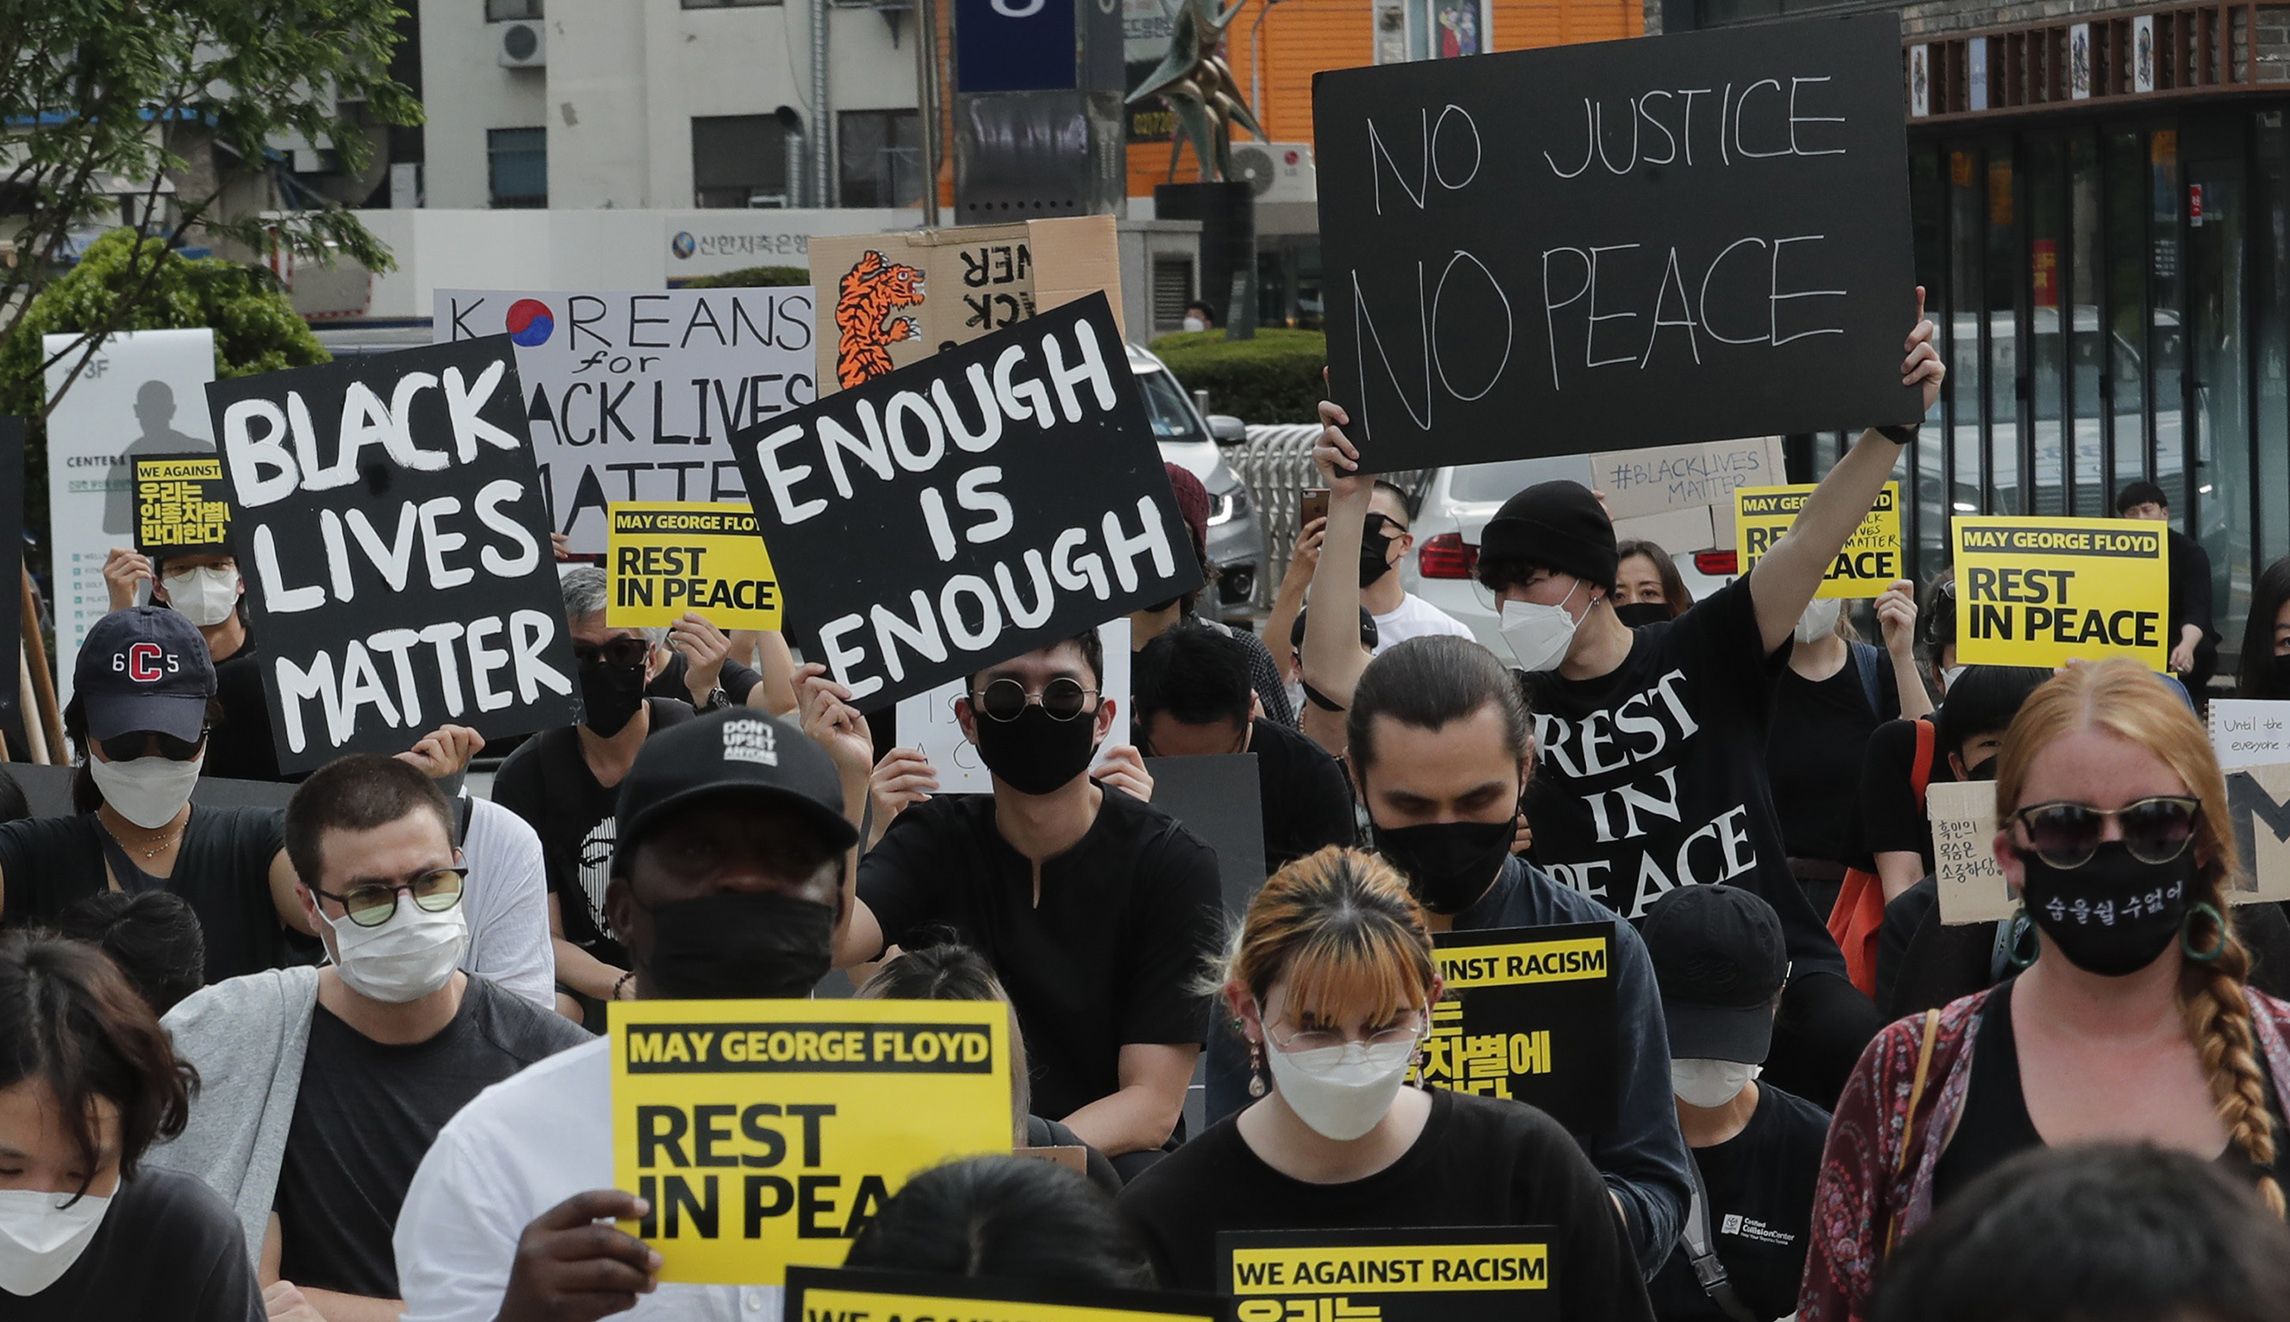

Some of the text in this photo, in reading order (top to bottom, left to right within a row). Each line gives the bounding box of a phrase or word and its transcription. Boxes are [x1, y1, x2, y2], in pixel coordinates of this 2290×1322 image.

[1366, 75, 1846, 216] NO JUSTICE
[1351, 235, 1847, 441] NO PEACE
[571, 350, 661, 374] for
[527, 382, 636, 446] ACK
[756, 318, 1118, 526] ENOUGH
[223, 359, 522, 508] BLACK
[139, 465, 220, 478] WE AGAINST
[139, 481, 203, 504] 우리는
[1668, 473, 1746, 503] MATTER
[1743, 496, 1777, 512] MAY
[616, 515, 761, 532] MAY GEORGE FLO
[919, 465, 1015, 563] IS
[141, 522, 227, 546] 반대한다
[253, 479, 541, 614] LIVES
[1964, 532, 2158, 553] MAY GEORGE FLOYD
[617, 546, 707, 576] REST
[1823, 551, 1895, 580] ACE
[617, 578, 776, 610] IN PEACE
[817, 495, 1177, 701] ENOUGH
[1968, 567, 2076, 604] REST
[1970, 604, 2159, 647] IN PEACE
[275, 609, 574, 754] MATTER
[1531, 668, 1700, 778] REST
[2223, 716, 2283, 732] Until the
[2231, 741, 2280, 753] everyone
[1581, 765, 1682, 843] IN
[1939, 820, 1978, 841] 흑인의
[1940, 841, 1977, 861] 목숨은
[1442, 950, 1605, 981] INST RACISM
[629, 1032, 990, 1064] MAY GEORGE FLOYD
[637, 1103, 837, 1169] REST
[638, 1175, 892, 1239] IN PEA
[1237, 1257, 1545, 1286] WE AGAINST RACISM
